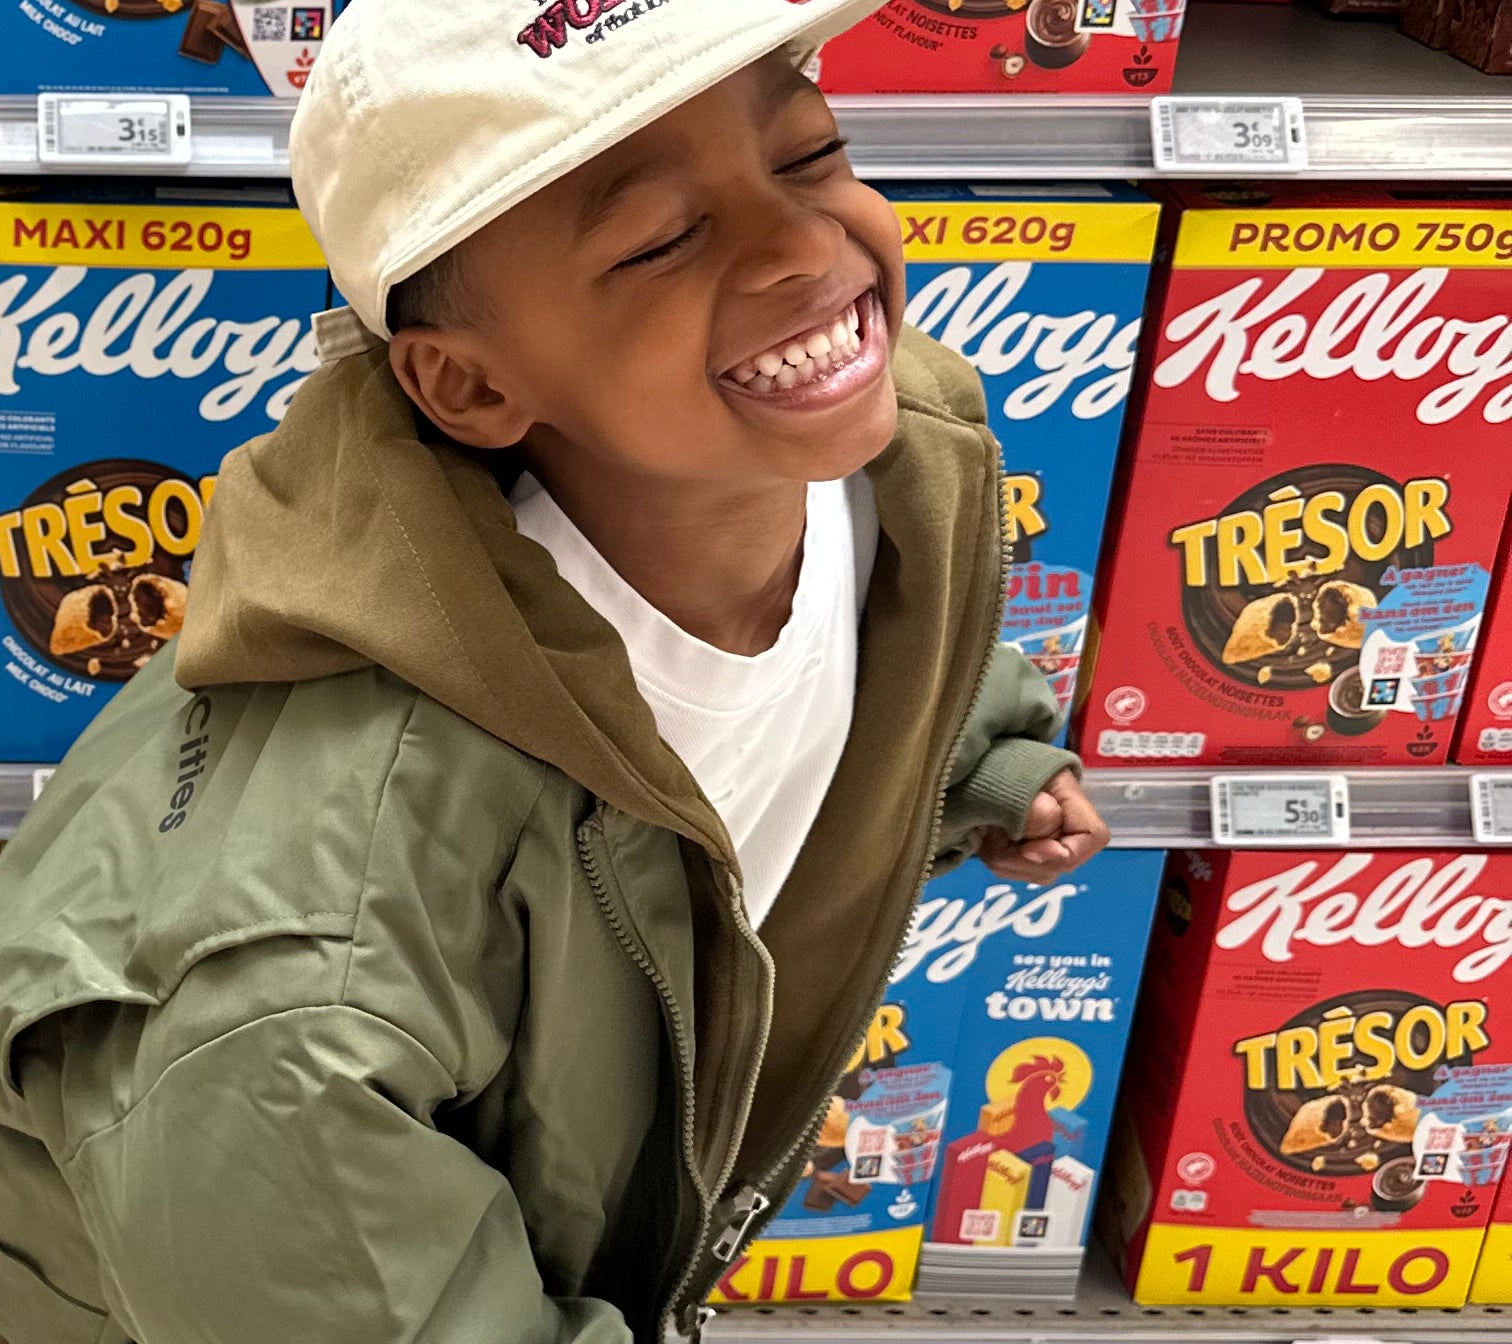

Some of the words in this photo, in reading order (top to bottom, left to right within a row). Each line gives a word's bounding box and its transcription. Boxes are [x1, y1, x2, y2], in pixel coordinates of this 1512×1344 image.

[585, 22, 606, 44] of
[603, 1, 646, 32] that
[909, 9, 978, 41] NOISETTES
[13, 217, 125, 250] MAXI
[141, 220, 252, 261] 620g
[961, 216, 1077, 252] 620g
[1228, 222, 1400, 253] PROMO
[1171, 478, 1453, 587] TRÉSOR
[1012, 955, 1047, 968] see
[1050, 954, 1087, 971] you
[1090, 953, 1112, 967] in
[985, 991, 1117, 1023] town
[1235, 1000, 1489, 1091] TRÉSOR
[1174, 1244, 1214, 1293] 1
[1239, 1246, 1450, 1296] KILO
